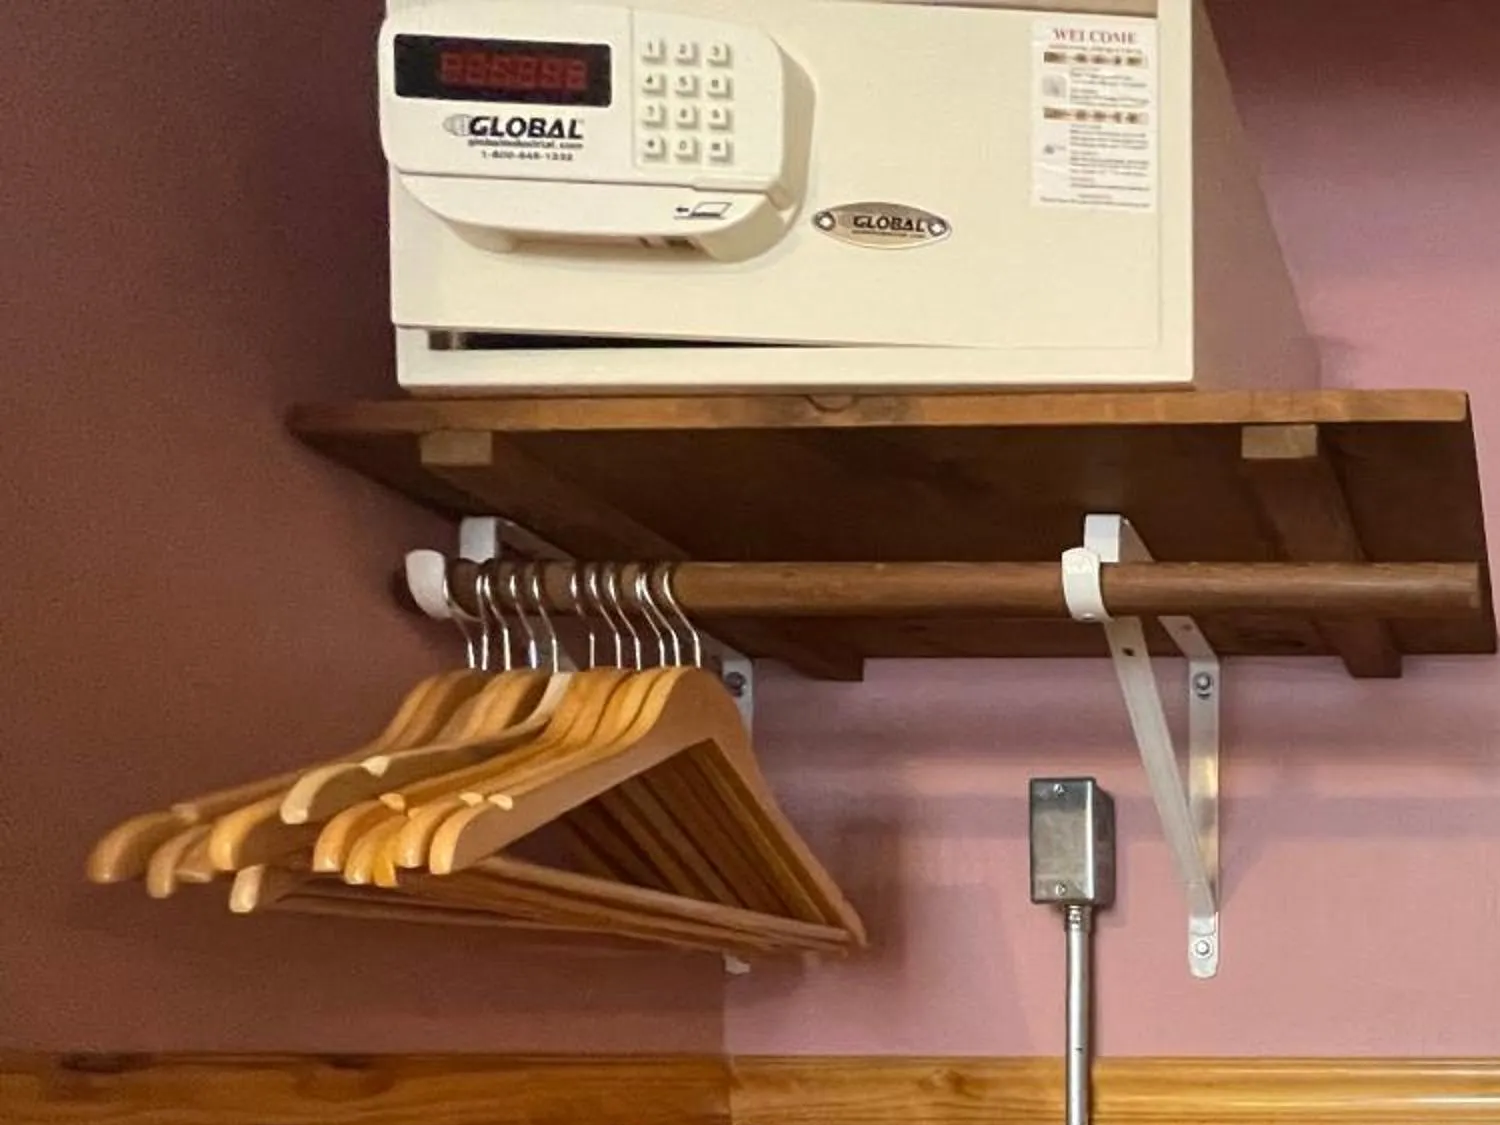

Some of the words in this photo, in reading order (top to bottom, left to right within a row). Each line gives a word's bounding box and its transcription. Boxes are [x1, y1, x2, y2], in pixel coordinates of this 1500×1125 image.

[1052, 28, 1138, 45] WELCOME
[469, 116, 583, 139] GLOBAL
[853, 215, 926, 233] GLOBAL
